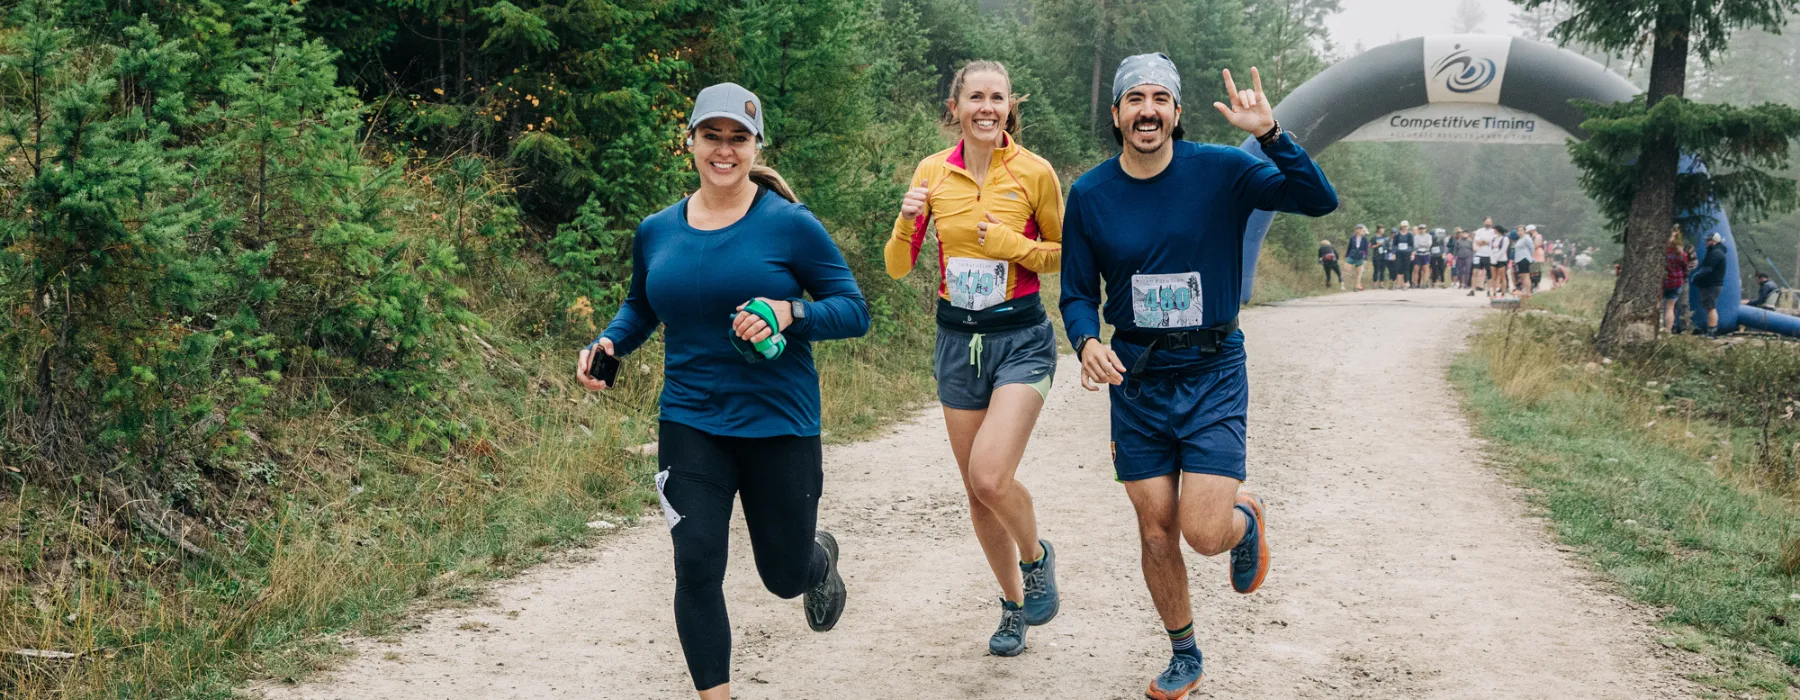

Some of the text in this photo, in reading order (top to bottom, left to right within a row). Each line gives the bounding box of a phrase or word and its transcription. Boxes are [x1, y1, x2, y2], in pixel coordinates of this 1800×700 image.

[1390, 115, 1535, 132] Competitive Timing
[956, 271, 994, 296] 479
[1144, 287, 1190, 311] 480
